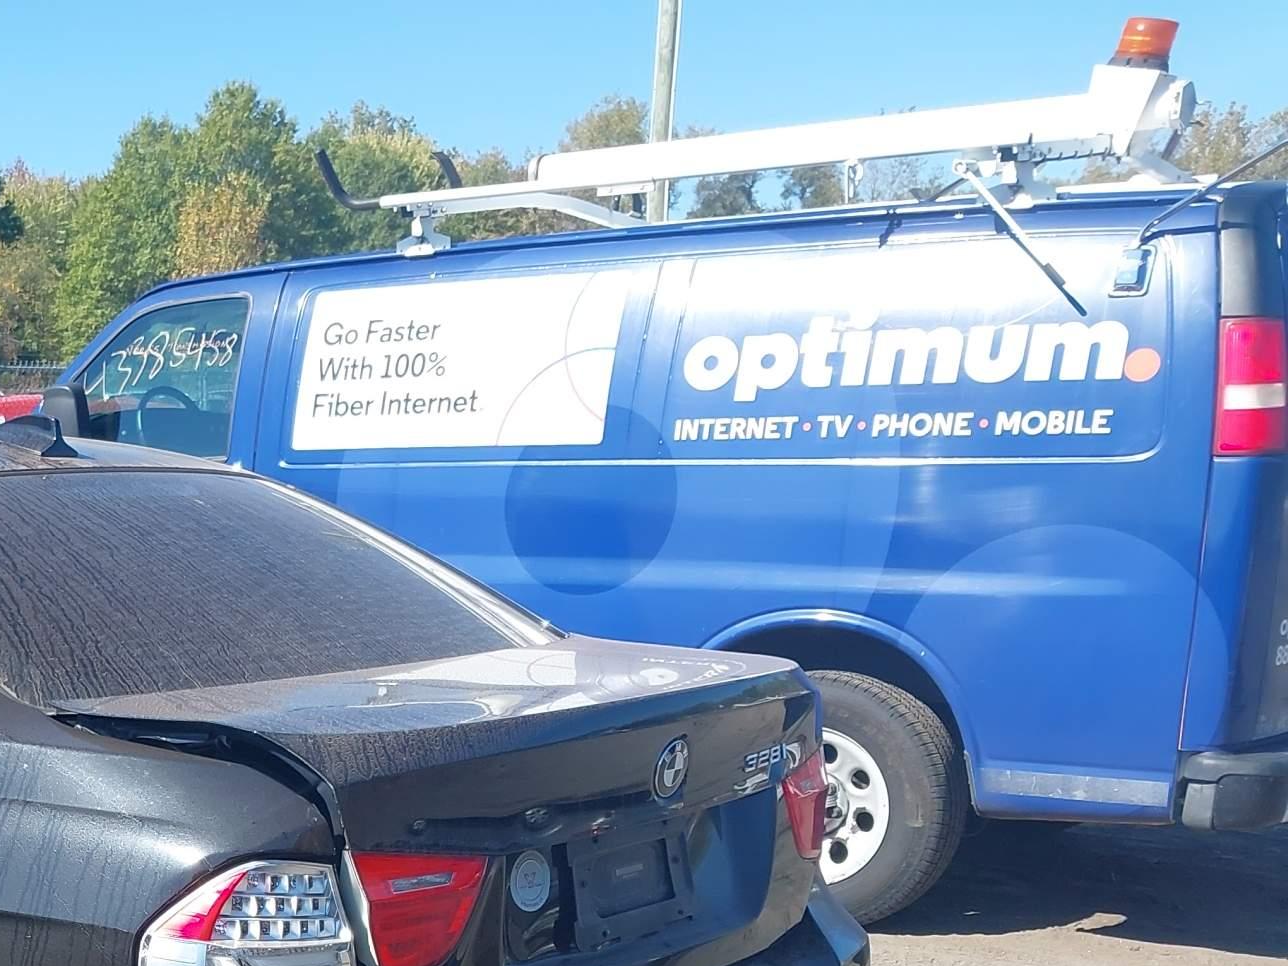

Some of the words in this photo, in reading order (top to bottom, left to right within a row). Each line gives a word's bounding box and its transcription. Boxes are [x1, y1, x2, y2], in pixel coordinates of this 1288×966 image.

[324, 322, 359, 346] Go
[365, 319, 442, 344] Faster
[319, 355, 374, 382] With
[380, 351, 448, 379] 100%
[312, 392, 375, 418] Fiber
[673, 415, 800, 441] INTERNET
[816, 414, 855, 438] TV
[871, 411, 974, 438] PHONE
[994, 408, 1114, 436] MOBILE
